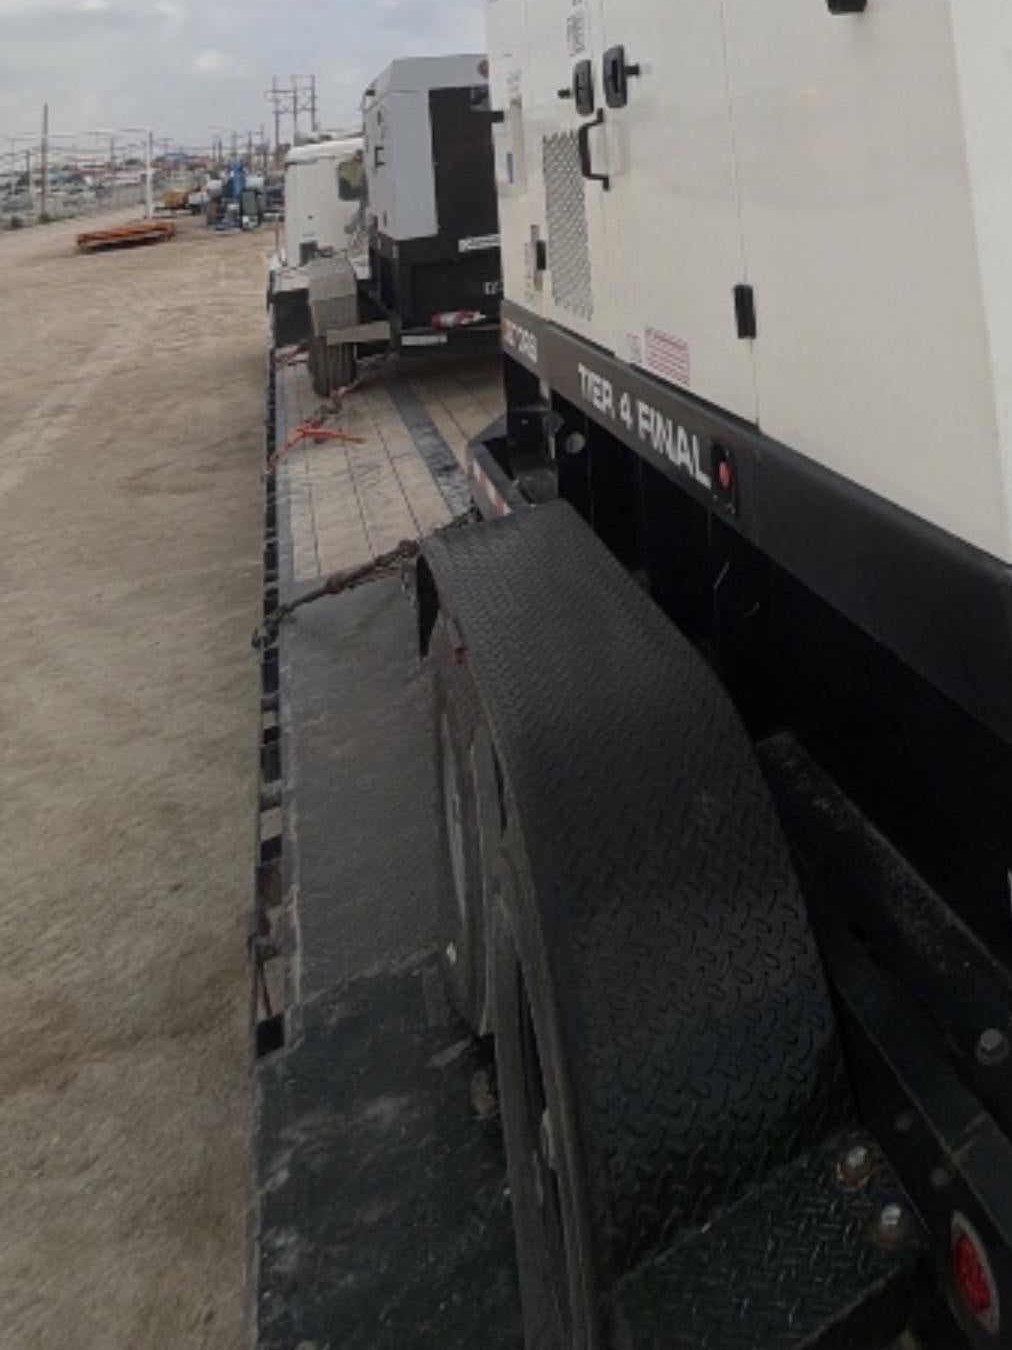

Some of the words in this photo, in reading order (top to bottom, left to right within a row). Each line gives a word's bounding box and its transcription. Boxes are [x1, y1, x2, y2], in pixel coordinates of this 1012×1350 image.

[577, 363, 616, 420] TIER
[619, 392, 634, 430] 4
[637, 400, 713, 489] FINAL
